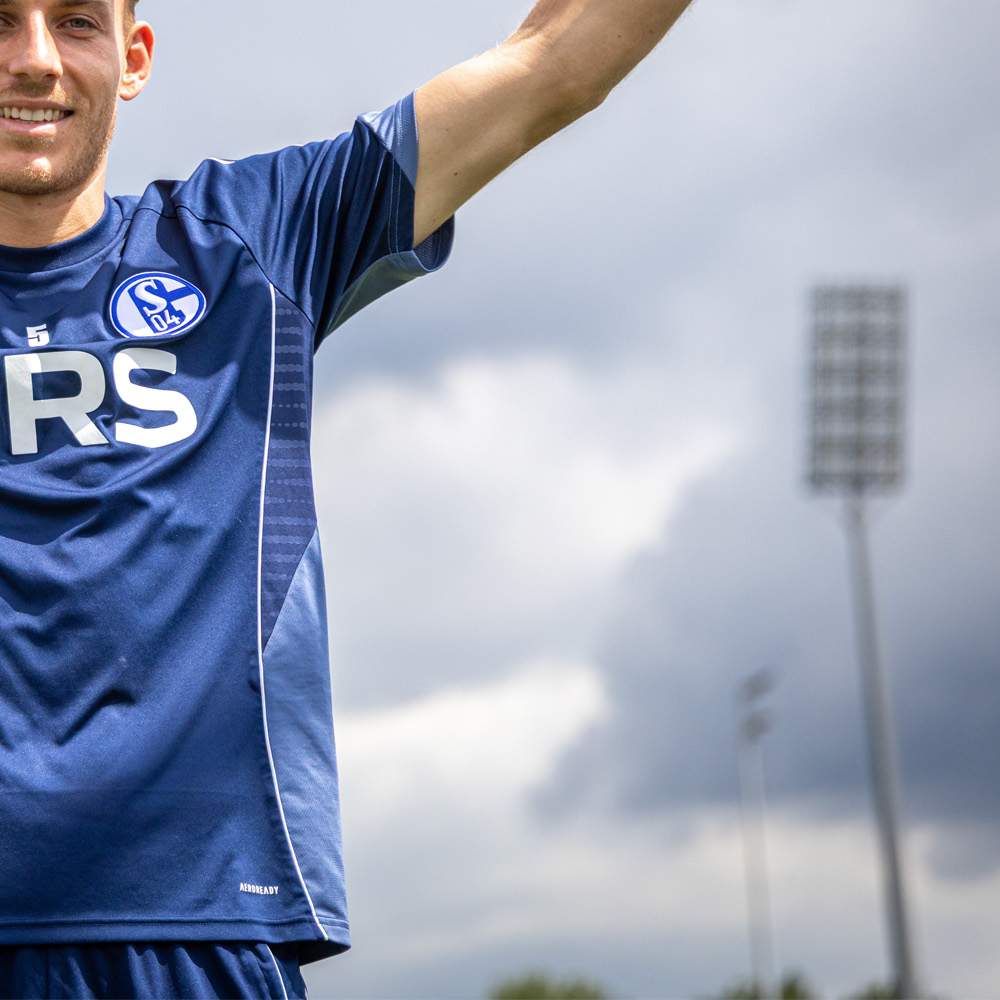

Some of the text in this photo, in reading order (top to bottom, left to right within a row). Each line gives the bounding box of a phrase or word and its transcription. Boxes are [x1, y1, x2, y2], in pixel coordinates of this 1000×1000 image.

[134, 278, 168, 317] S
[149, 309, 181, 332] 04
[26, 323, 50, 347] 5
